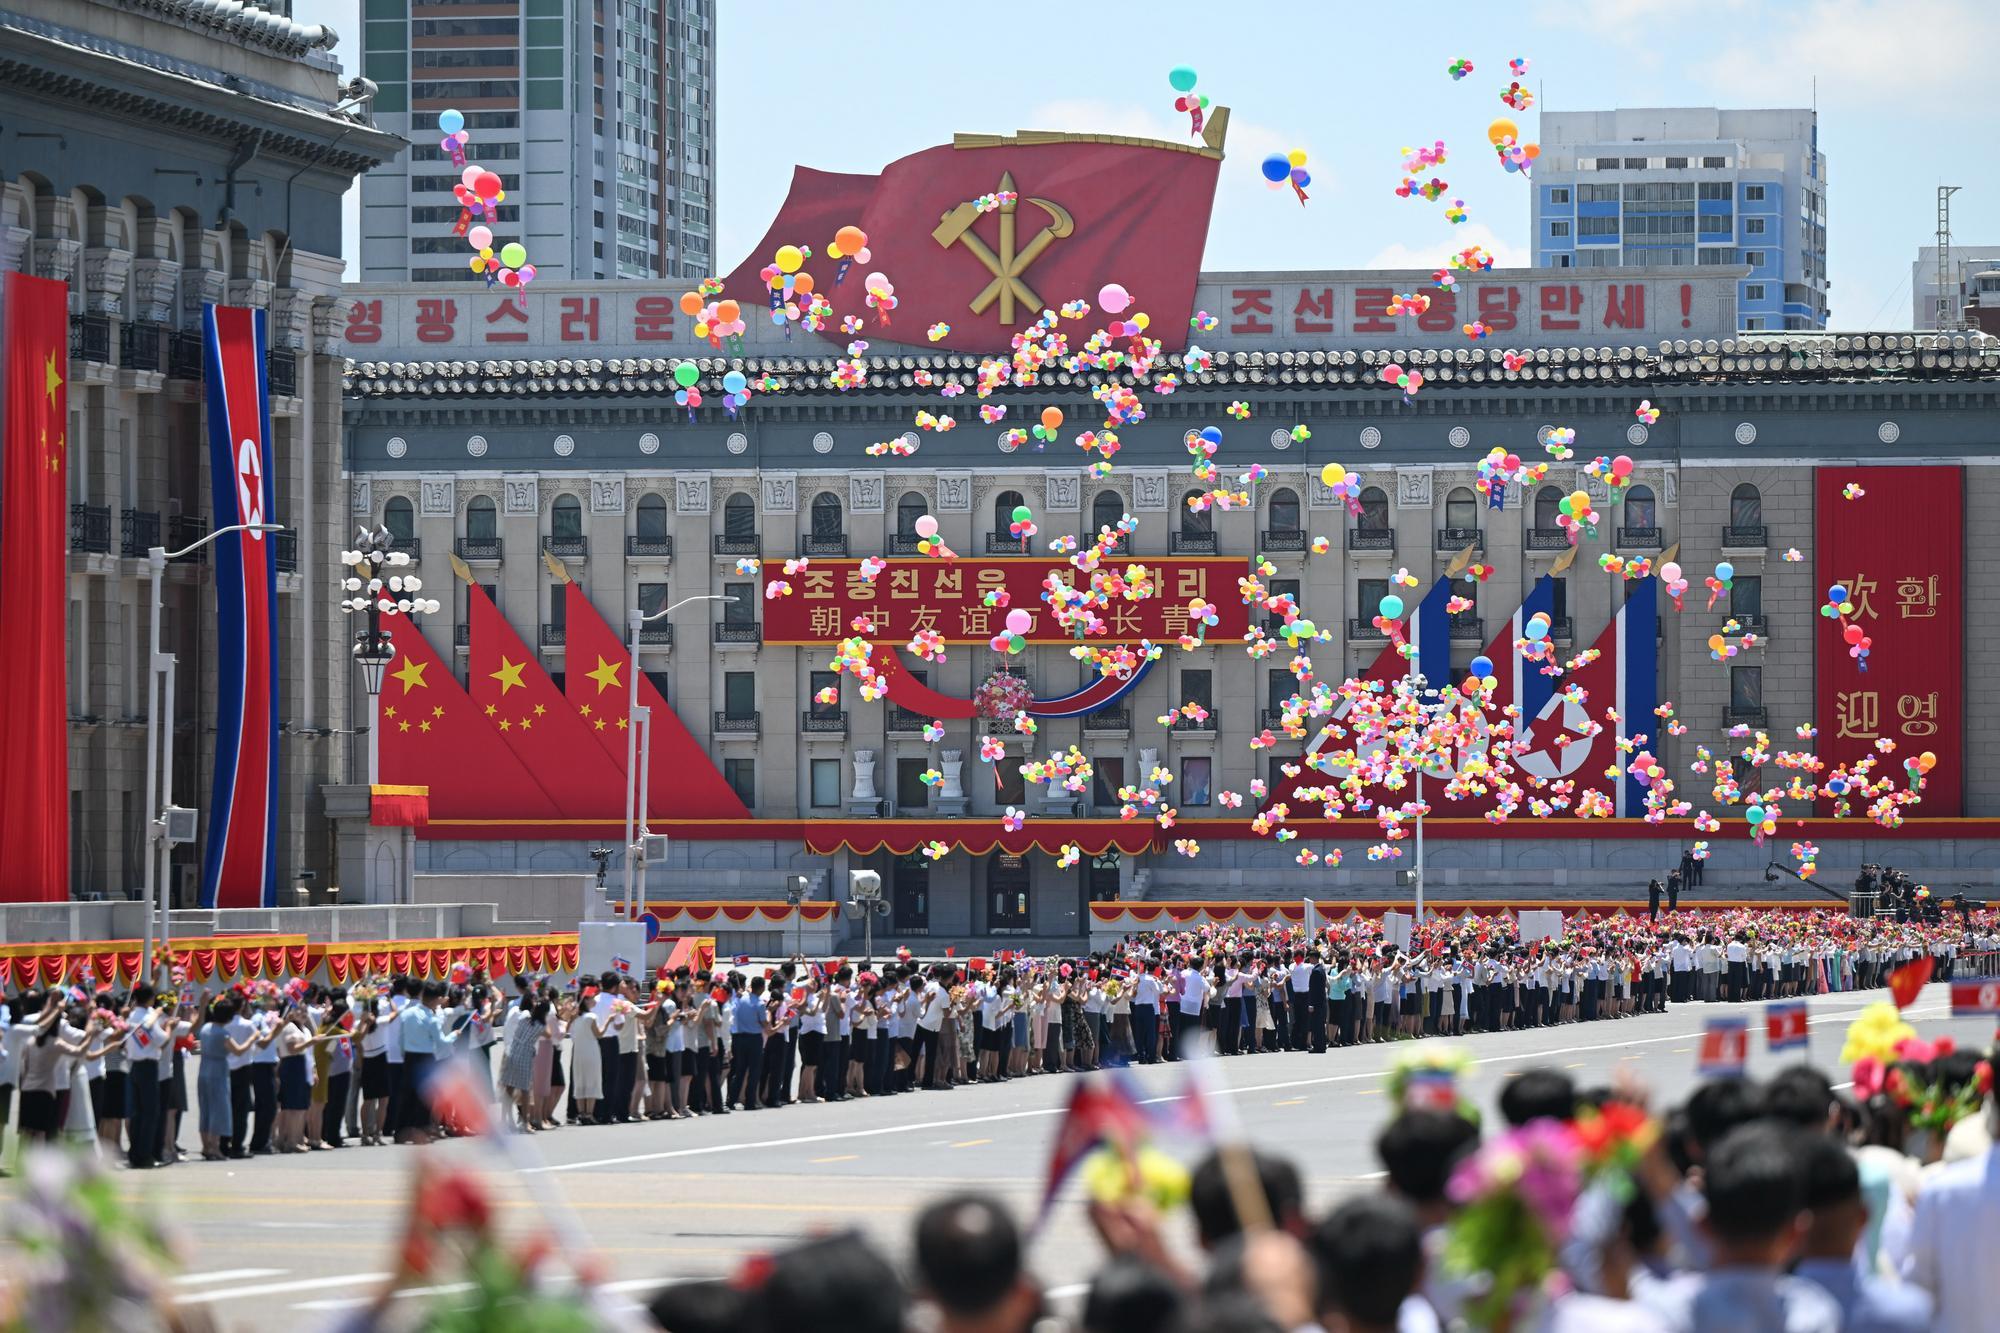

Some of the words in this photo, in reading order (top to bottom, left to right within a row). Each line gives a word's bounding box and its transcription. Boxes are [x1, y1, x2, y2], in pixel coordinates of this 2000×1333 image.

[345, 297, 674, 343] 영광스러운
[803, 568, 1006, 600] 조중친선은
[1047, 568, 1206, 600] 하리
[809, 605, 1191, 636] 朝中友谊长青
